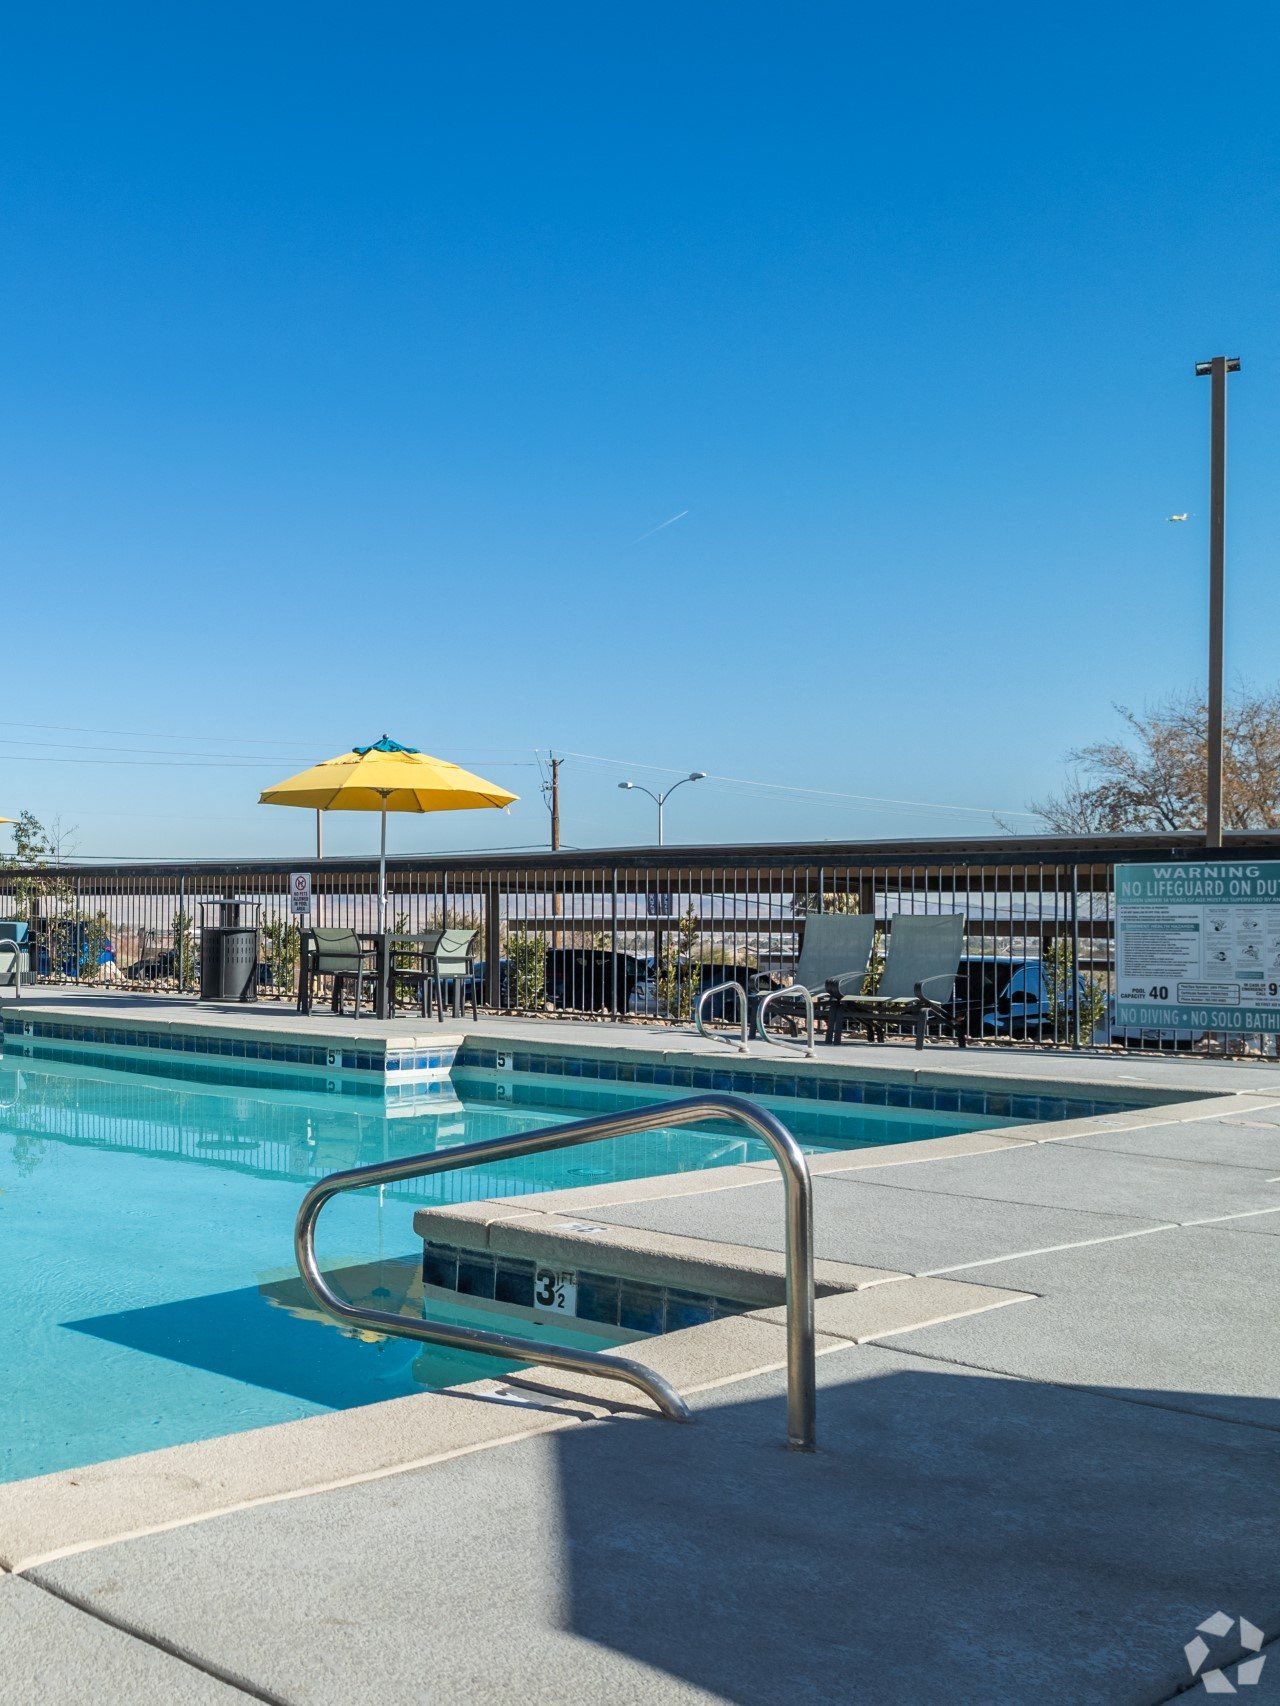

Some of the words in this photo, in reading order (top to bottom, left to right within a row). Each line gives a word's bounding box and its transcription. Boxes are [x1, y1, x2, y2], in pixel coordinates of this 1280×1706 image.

[1153, 866, 1260, 879] WARNING
[1122, 881, 1141, 896] NO
[1147, 880, 1224, 896] LIFEGUARD
[1229, 880, 1251, 896] ON
[1257, 880, 1280, 896] DU
[1149, 986, 1168, 1000] 40
[1120, 1008, 1137, 1023] NO
[1140, 1008, 1179, 1025] DIVING
[1190, 1010, 1208, 1026] NO
[1211, 1011, 1242, 1028] SOLO
[498, 1052, 506, 1068] 5
